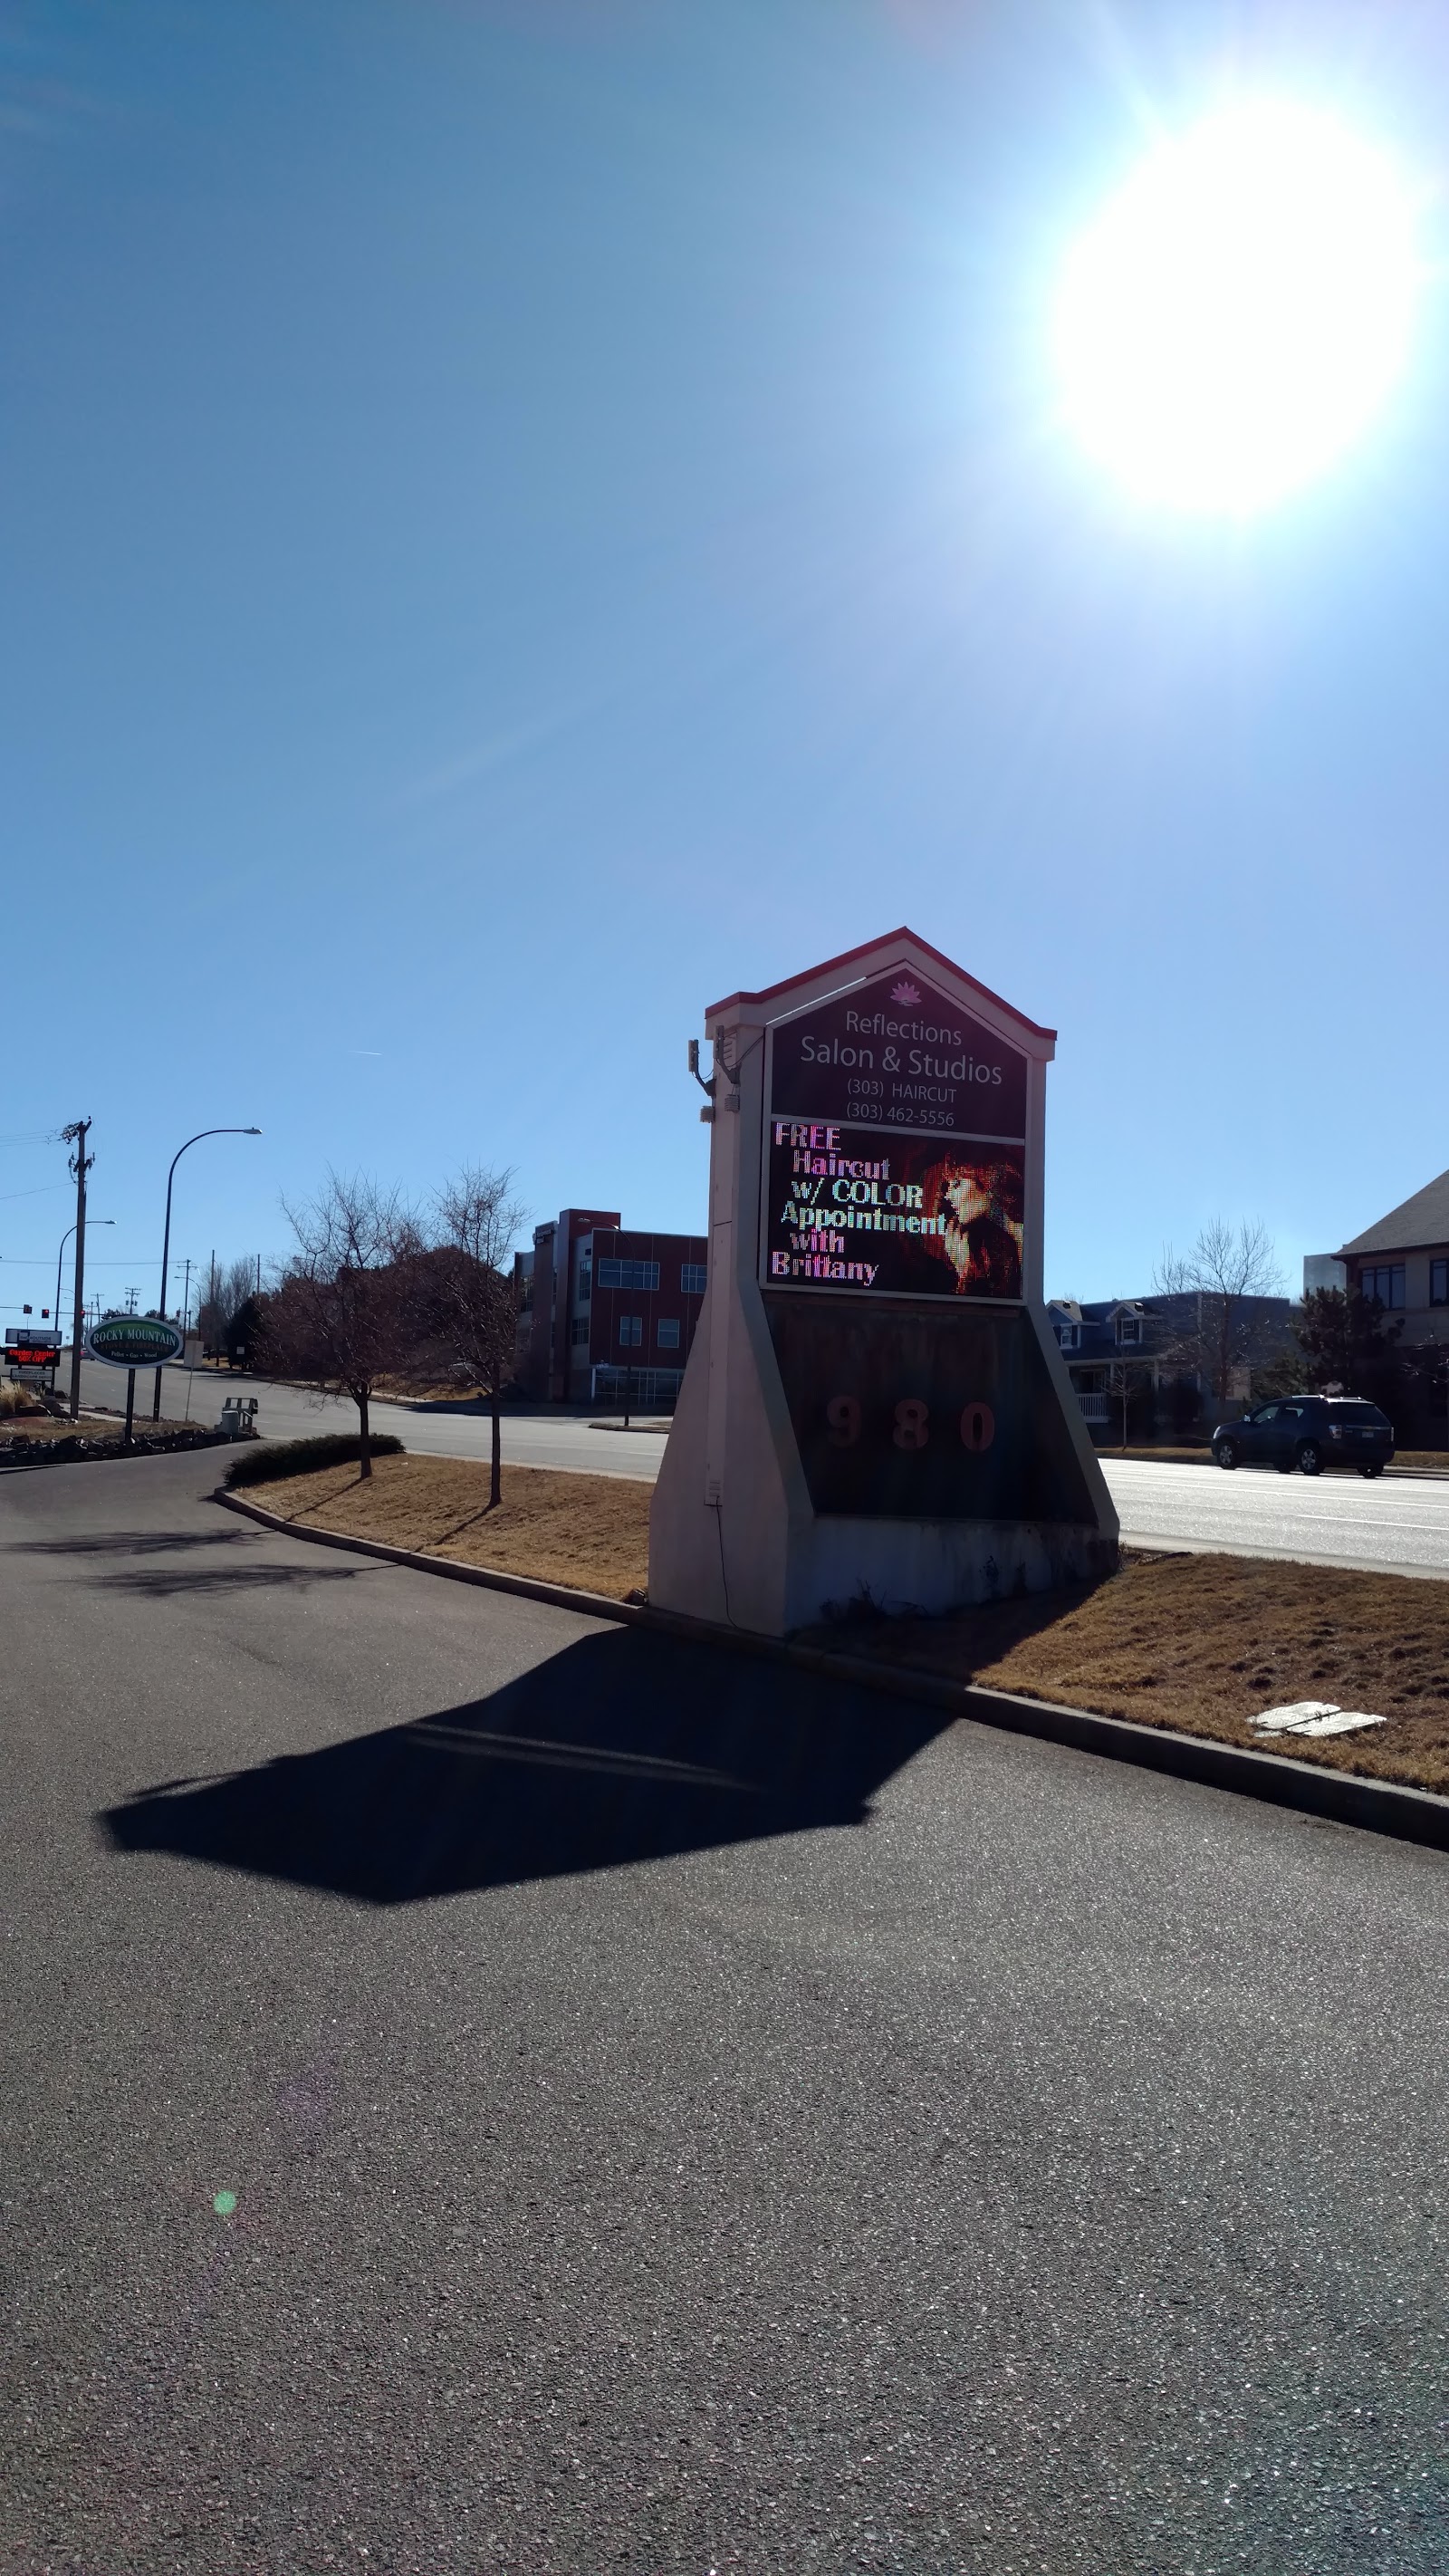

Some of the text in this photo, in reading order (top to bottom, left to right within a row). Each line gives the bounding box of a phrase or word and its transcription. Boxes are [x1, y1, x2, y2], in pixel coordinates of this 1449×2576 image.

[845, 1010, 962, 1046] Reflections
[800, 1035, 1003, 1085] Salon & Studios
[847, 1078, 957, 1103] (303) HAIRCUT
[846, 1102, 955, 1127] (303) 462-5556
[775, 1122, 841, 1150] FREE
[792, 1149, 890, 1180] Haircut
[791, 1177, 924, 1208] w/ COLOR
[781, 1200, 947, 1235] Appointment
[790, 1229, 845, 1254] with
[772, 1251, 880, 1286] Brittany
[92, 1329, 176, 1346] ROCKY MOUNTAIN
